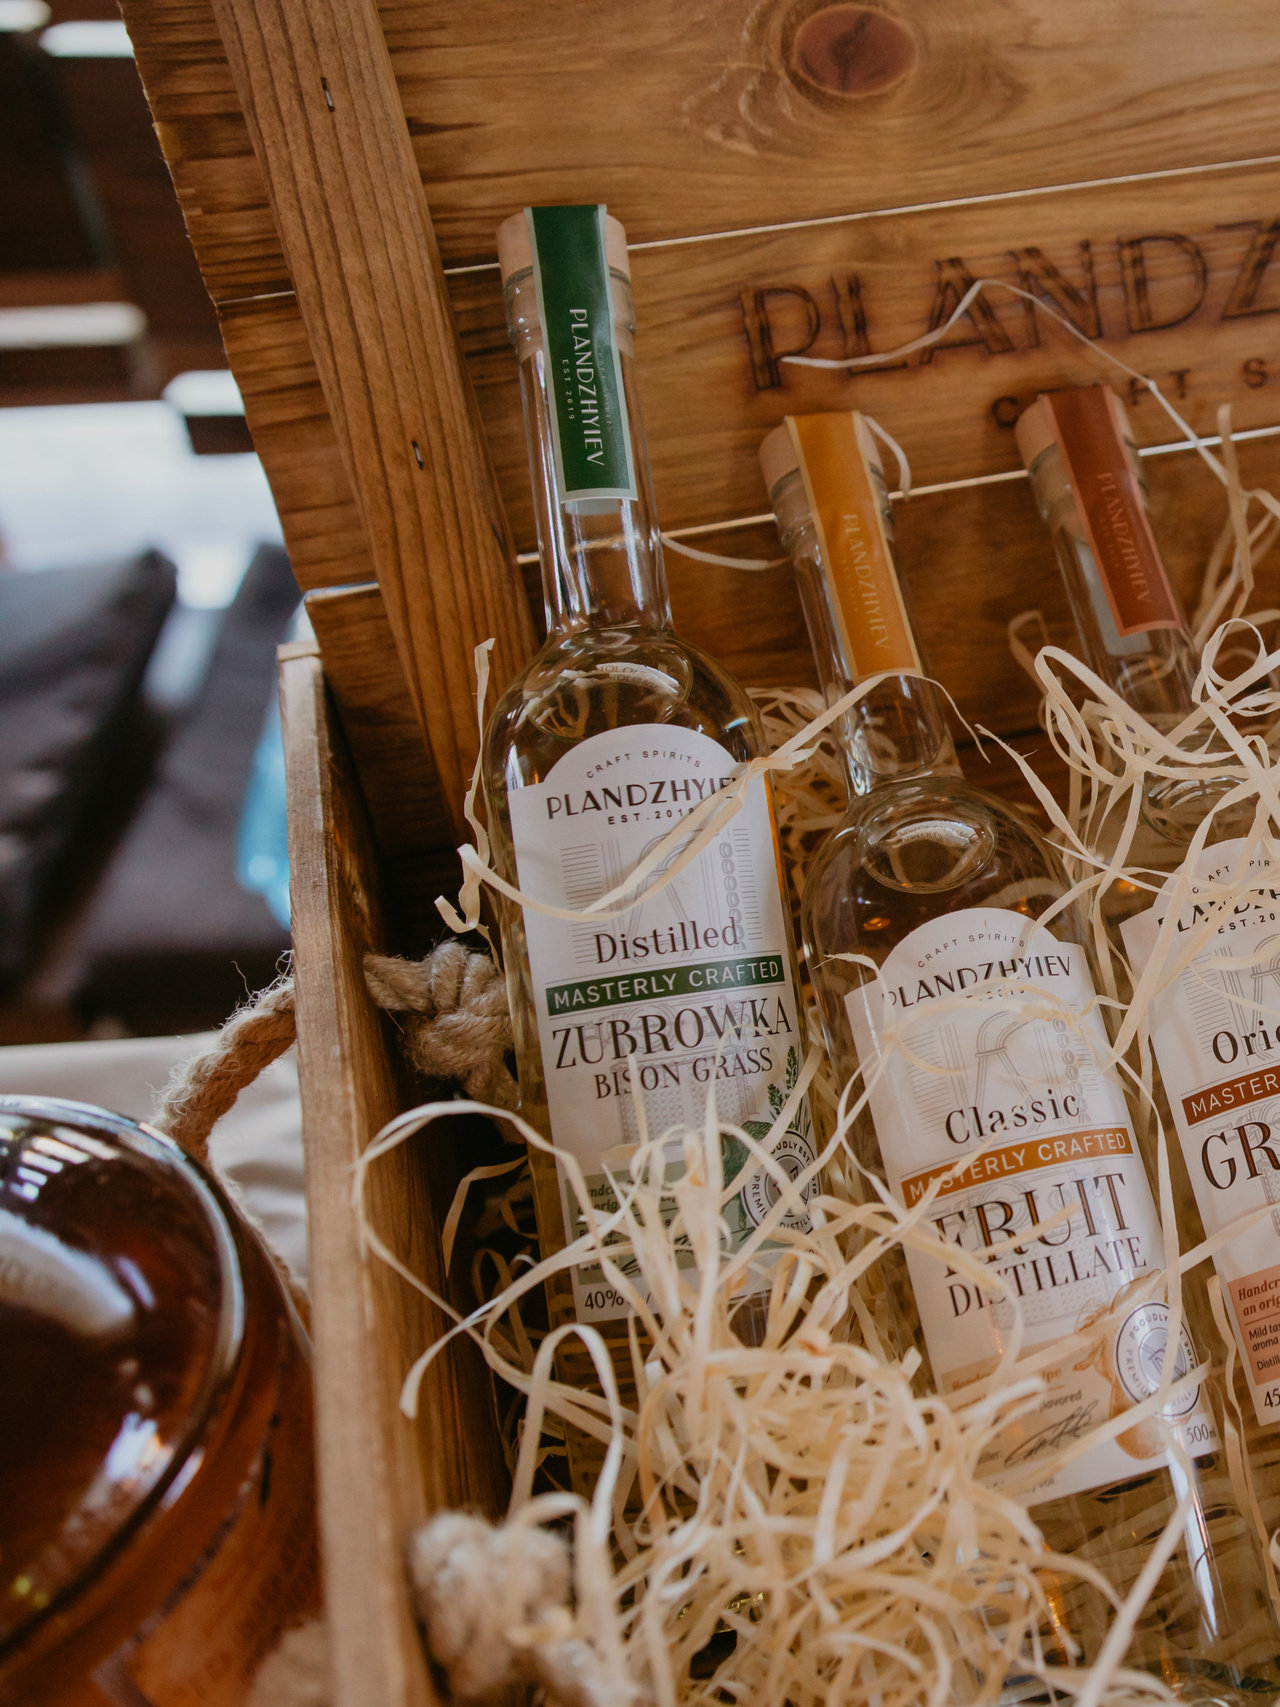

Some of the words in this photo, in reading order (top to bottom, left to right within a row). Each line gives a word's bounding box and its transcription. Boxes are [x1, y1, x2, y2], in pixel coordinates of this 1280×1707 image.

[569, 308, 605, 466] PLANDZHYIEV
[991, 367, 1192, 429] CFT
[586, 753, 631, 779] CRAFT
[642, 750, 701, 768] SPIRITS
[546, 777, 738, 819] PLANDZHYIE
[1192, 865, 1231, 894] CAFT
[592, 916, 739, 964] Distilled
[917, 938, 959, 968] CRAFT
[968, 933, 1025, 948] SPIRITS
[553, 974, 677, 1010] MASTERLY
[688, 961, 779, 987] CRAFTED
[552, 996, 793, 1070] ZUBROWKA
[595, 1061, 682, 1099] BISON
[692, 1047, 773, 1083] GRASS
[945, 1088, 1080, 1144] Classic
[1037, 1132, 1126, 1161] CRAFTED
[930, 1172, 1131, 1279] FRUIT
[584, 1289, 625, 1310] 40%
[1242, 1303, 1257, 1317] an
[1249, 1323, 1267, 1341] Mild
[1252, 1337, 1279, 1352] aroma
